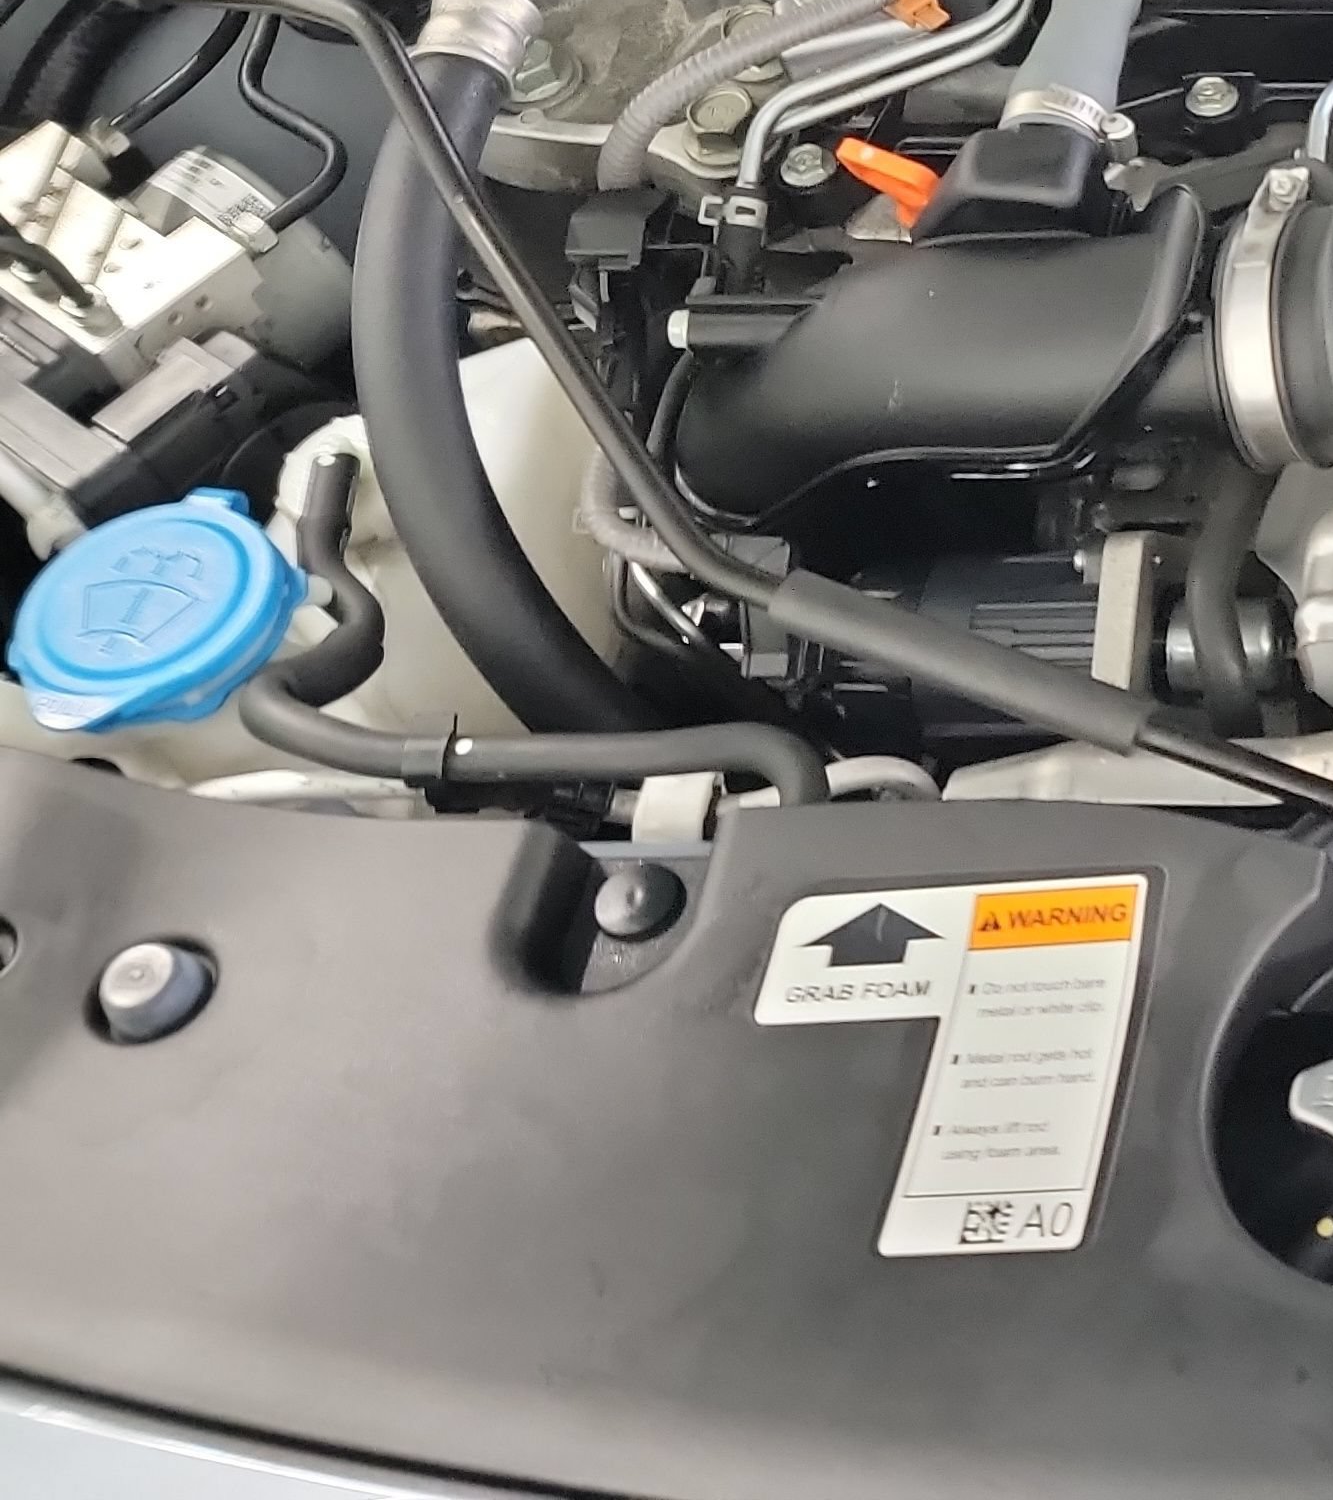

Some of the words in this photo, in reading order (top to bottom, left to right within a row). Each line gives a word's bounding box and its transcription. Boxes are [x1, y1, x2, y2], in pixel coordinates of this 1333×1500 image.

[1008, 903, 1128, 931] WARNING
[785, 982, 854, 1003] GRAB
[860, 980, 931, 999] FOAM
[1016, 1202, 1074, 1239] A0
